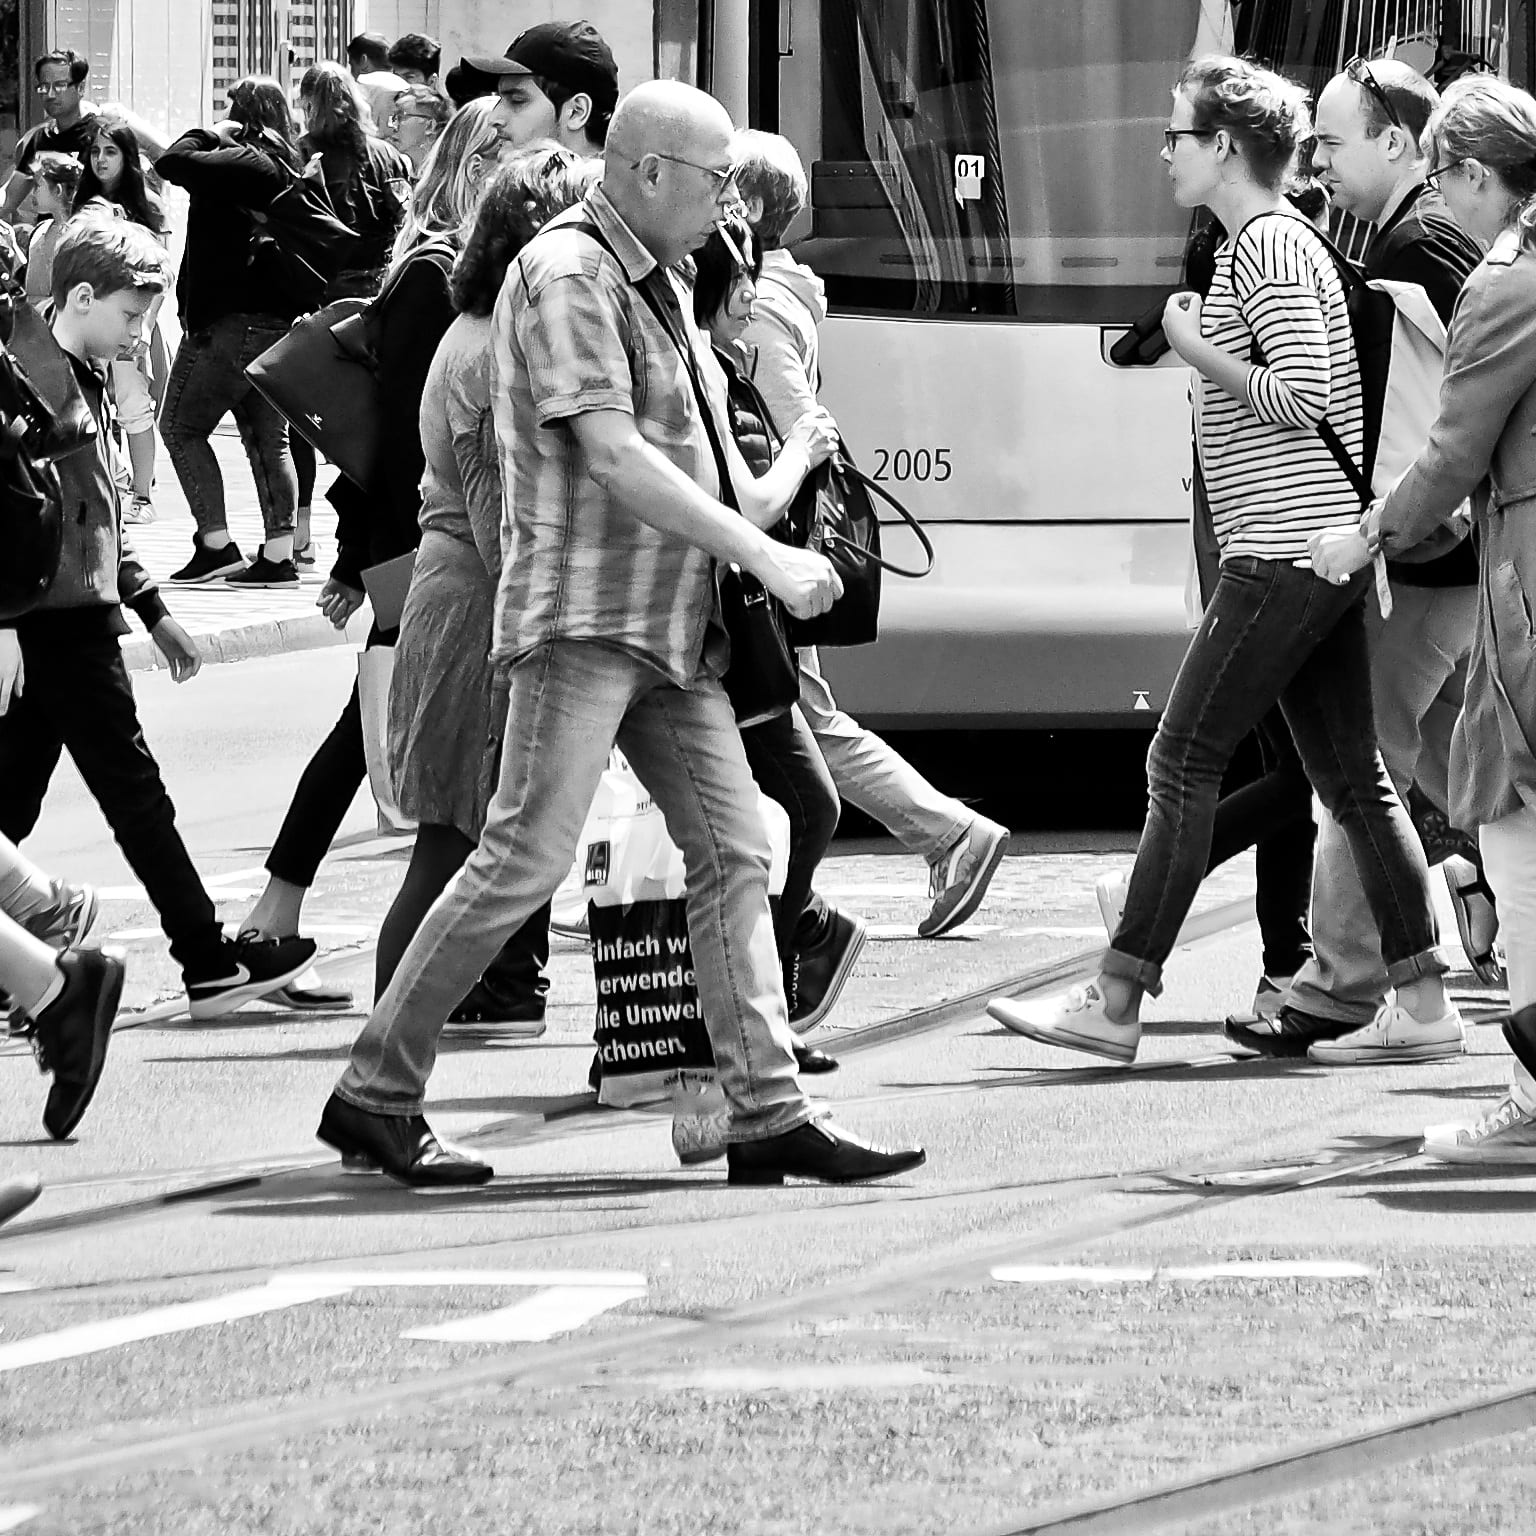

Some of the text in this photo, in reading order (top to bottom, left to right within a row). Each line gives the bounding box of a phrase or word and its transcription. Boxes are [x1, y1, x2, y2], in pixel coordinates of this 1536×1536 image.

[957, 159, 979, 177] 01
[872, 448, 952, 481] 2005
[592, 934, 660, 962] infach
